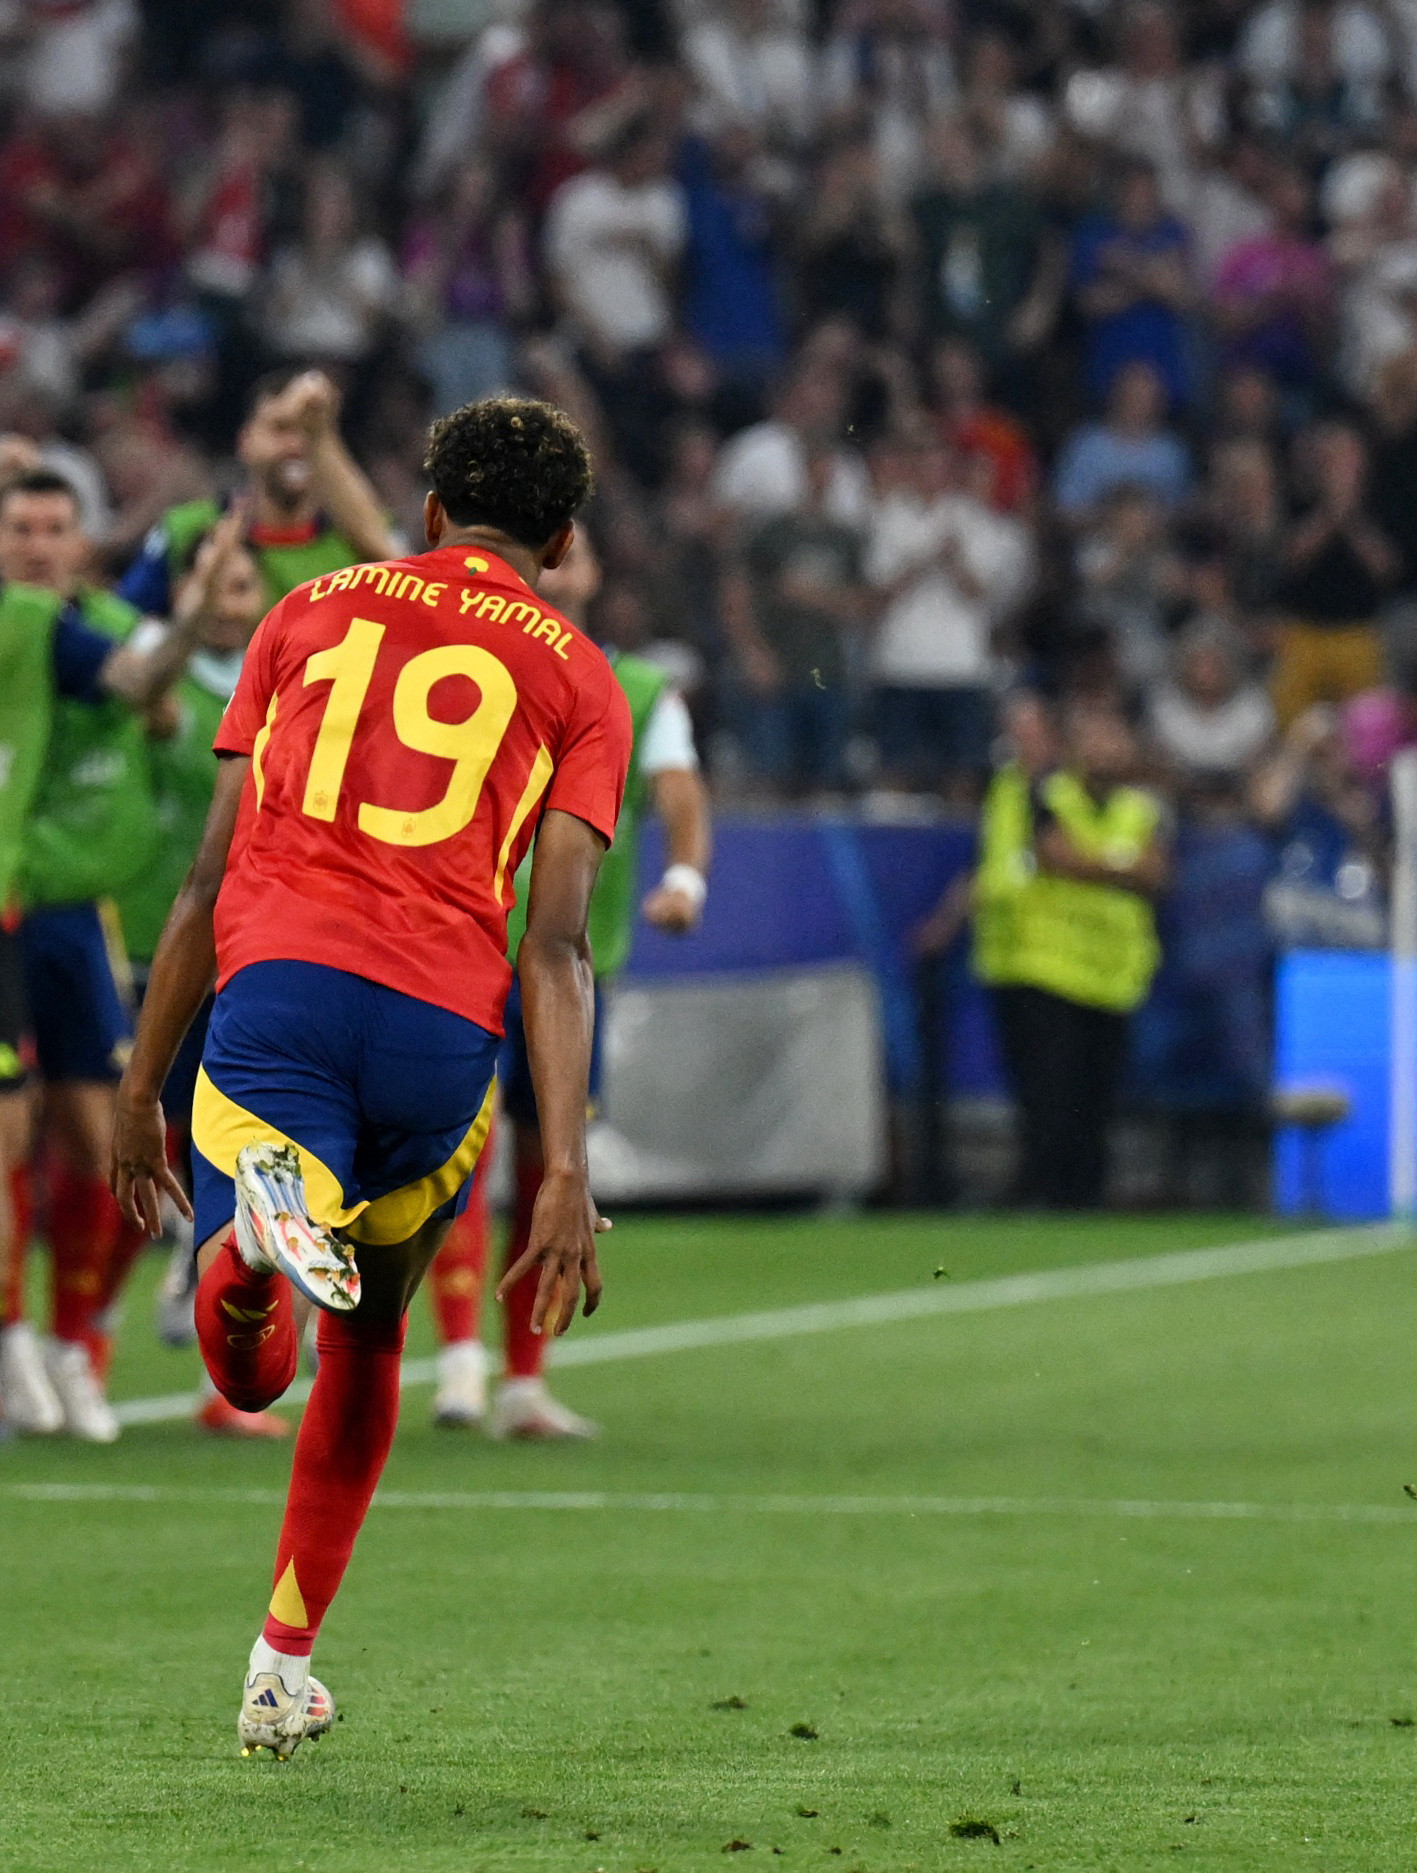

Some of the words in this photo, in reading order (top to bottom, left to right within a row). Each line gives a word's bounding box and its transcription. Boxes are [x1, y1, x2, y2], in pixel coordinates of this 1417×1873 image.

[309, 566, 448, 607] LAMINE
[459, 588, 573, 660] YAMAL
[302, 617, 518, 847] 19
